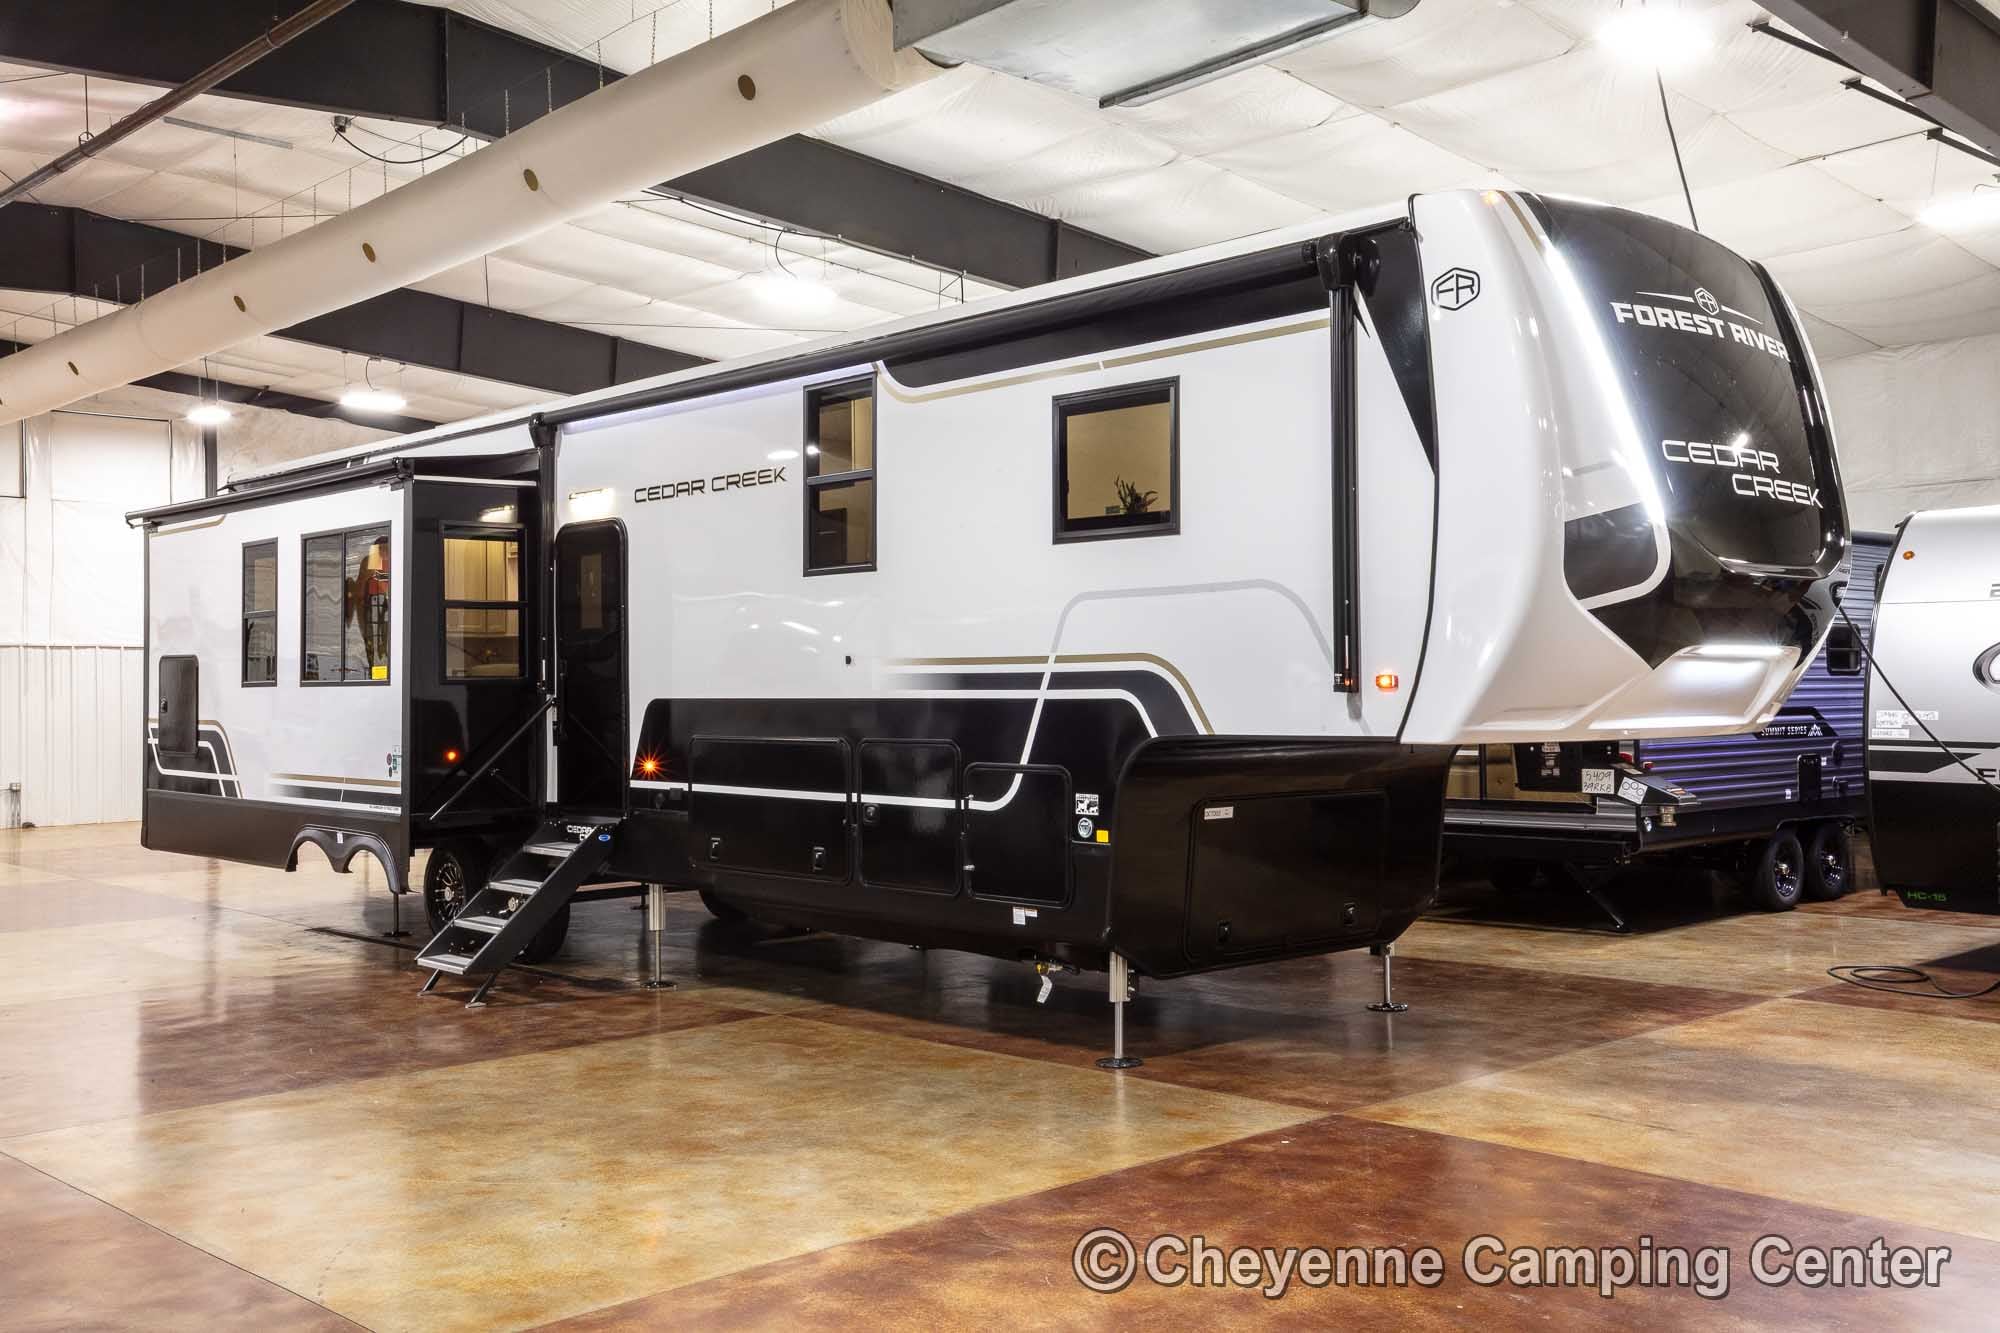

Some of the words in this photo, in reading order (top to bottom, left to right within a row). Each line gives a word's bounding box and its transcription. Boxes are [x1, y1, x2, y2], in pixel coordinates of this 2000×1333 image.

[1609, 302, 1725, 338] FOREST
[1727, 322, 1791, 363] RIVER
[1661, 439, 1781, 474] CEDAR
[634, 479, 706, 504] CEDAR
[711, 466, 787, 492] CREEK
[1731, 473, 1824, 509] CREEK
[1761, 726, 1786, 736] SUMMIT
[1787, 725, 1808, 735] SERIES
